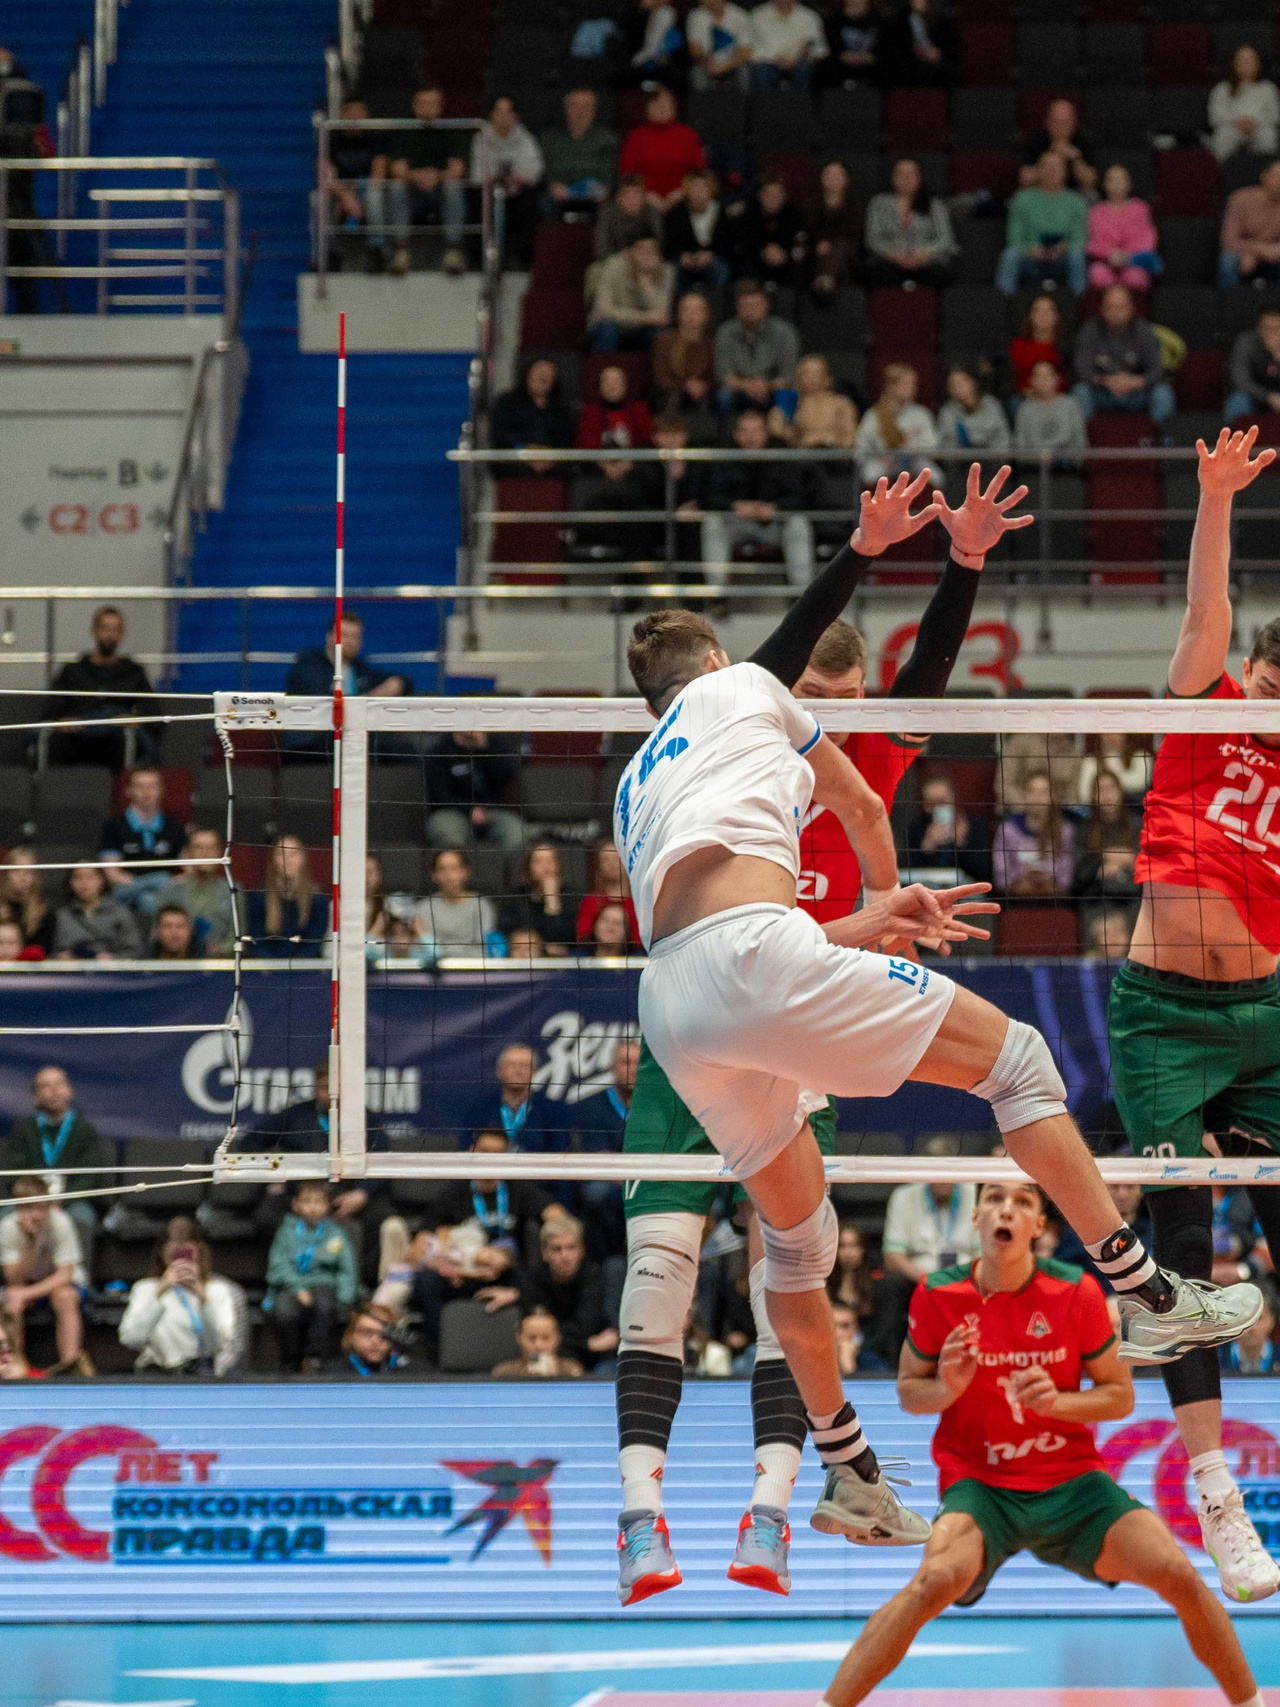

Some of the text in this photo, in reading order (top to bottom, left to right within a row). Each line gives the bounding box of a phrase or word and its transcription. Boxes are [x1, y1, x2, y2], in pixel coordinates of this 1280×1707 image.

[241, 697, 275, 705] Senoh
[888, 958, 919, 987] 15
[114, 1452, 219, 1483] ЛЕТ
[115, 1496, 453, 1519] КОМСОМОЛЬСКАЯ
[115, 1527, 325, 1561] ПРАВДА
